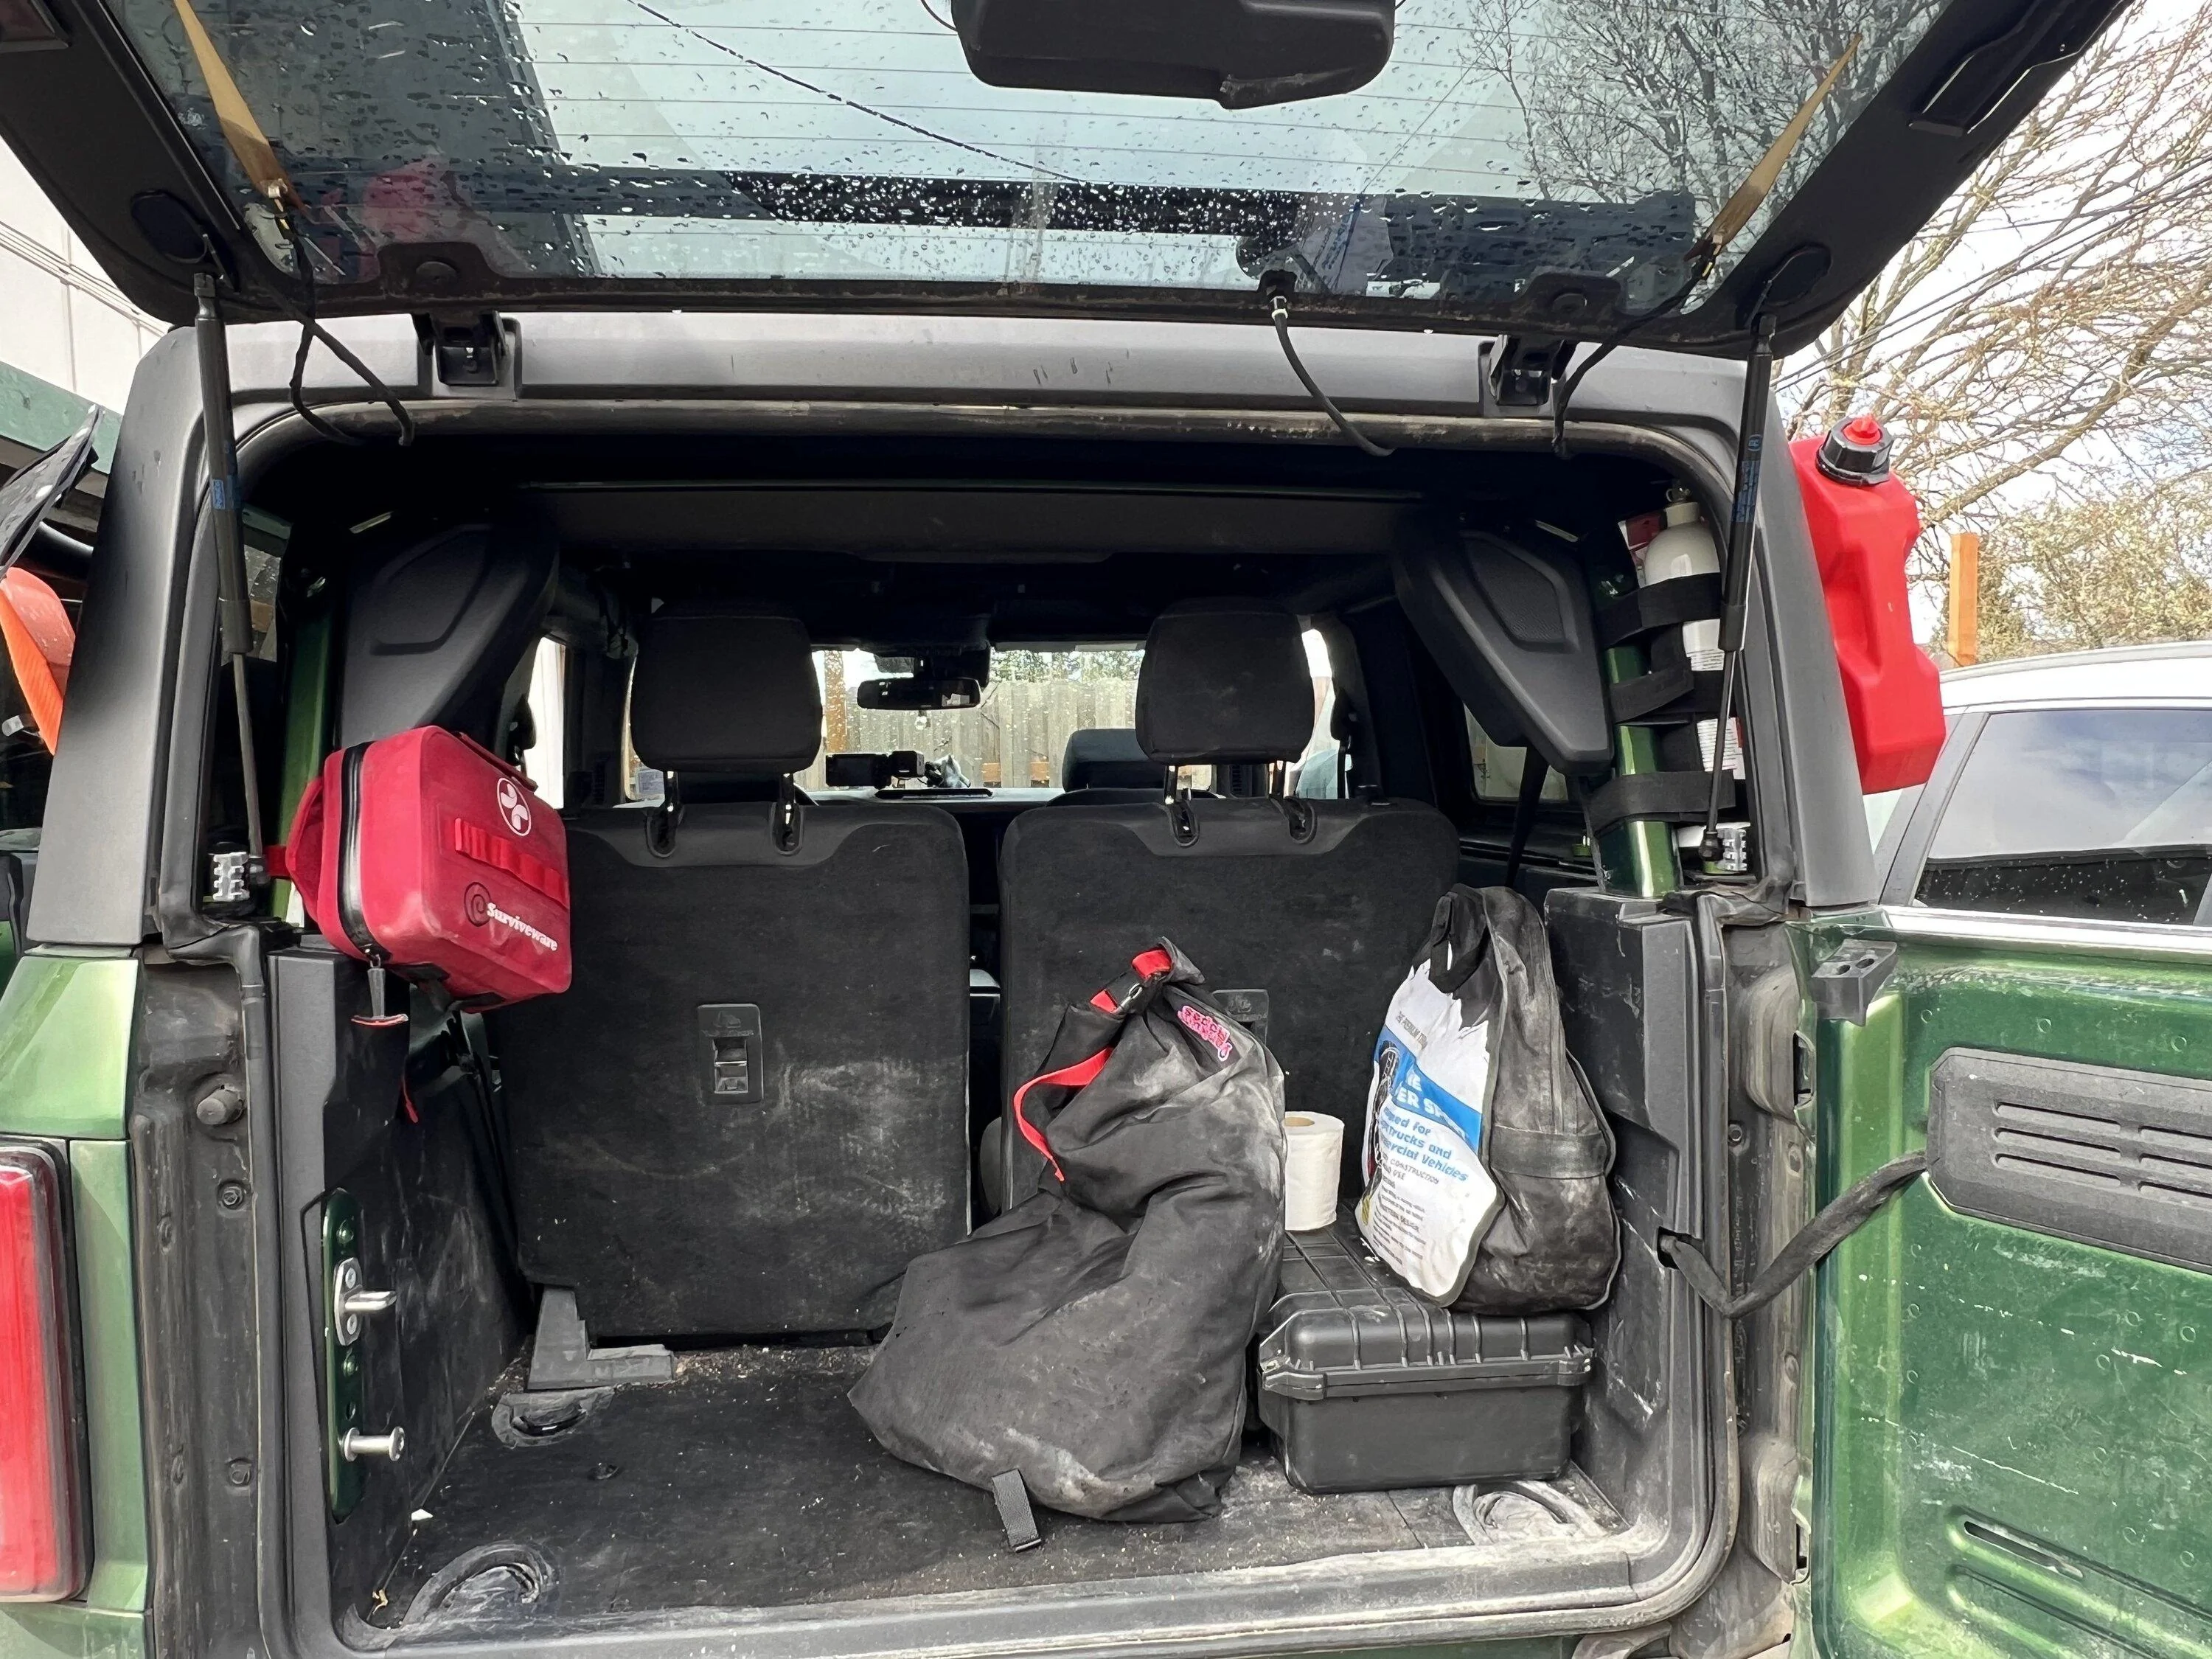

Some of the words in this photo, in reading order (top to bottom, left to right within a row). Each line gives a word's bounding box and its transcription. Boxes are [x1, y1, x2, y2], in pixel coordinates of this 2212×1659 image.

[487, 902, 558, 951] Surviveware
[1412, 1121, 1431, 1136] for
[1428, 1144, 1452, 1160] and
